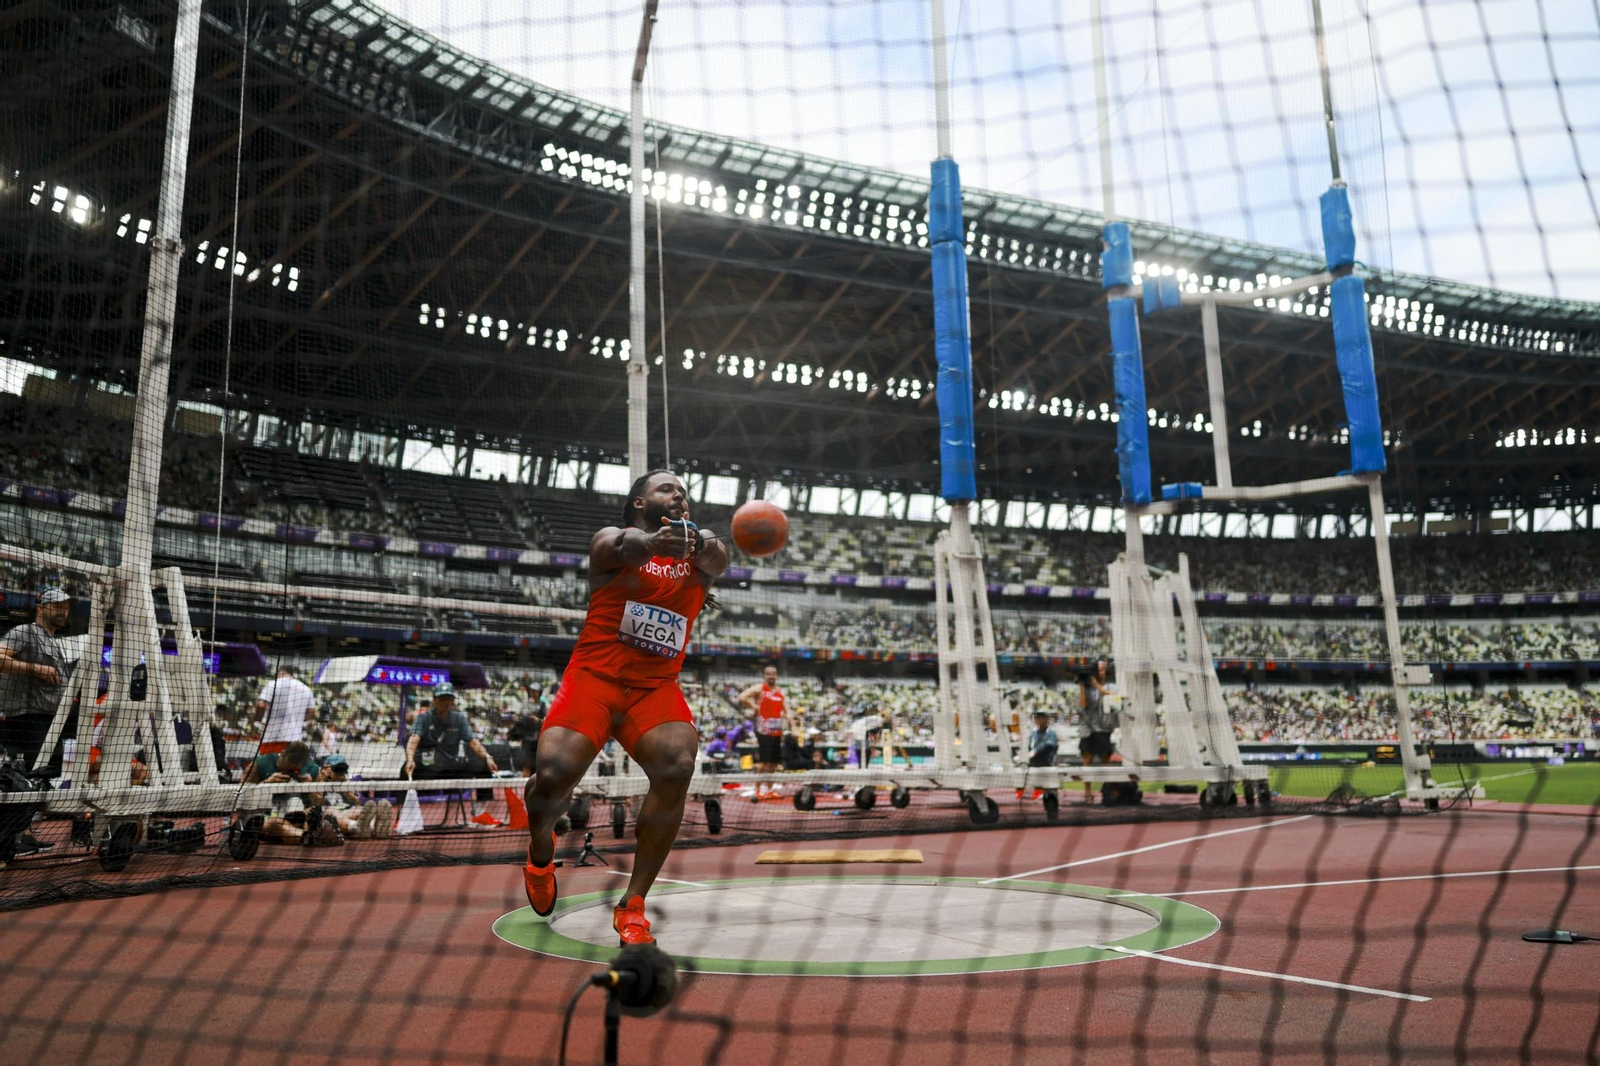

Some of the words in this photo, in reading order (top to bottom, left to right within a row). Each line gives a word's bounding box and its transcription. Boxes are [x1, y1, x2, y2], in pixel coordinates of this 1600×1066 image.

[670, 562, 691, 579] RICO
[645, 606, 683, 631] TDK
[631, 619, 677, 646] VEGA
